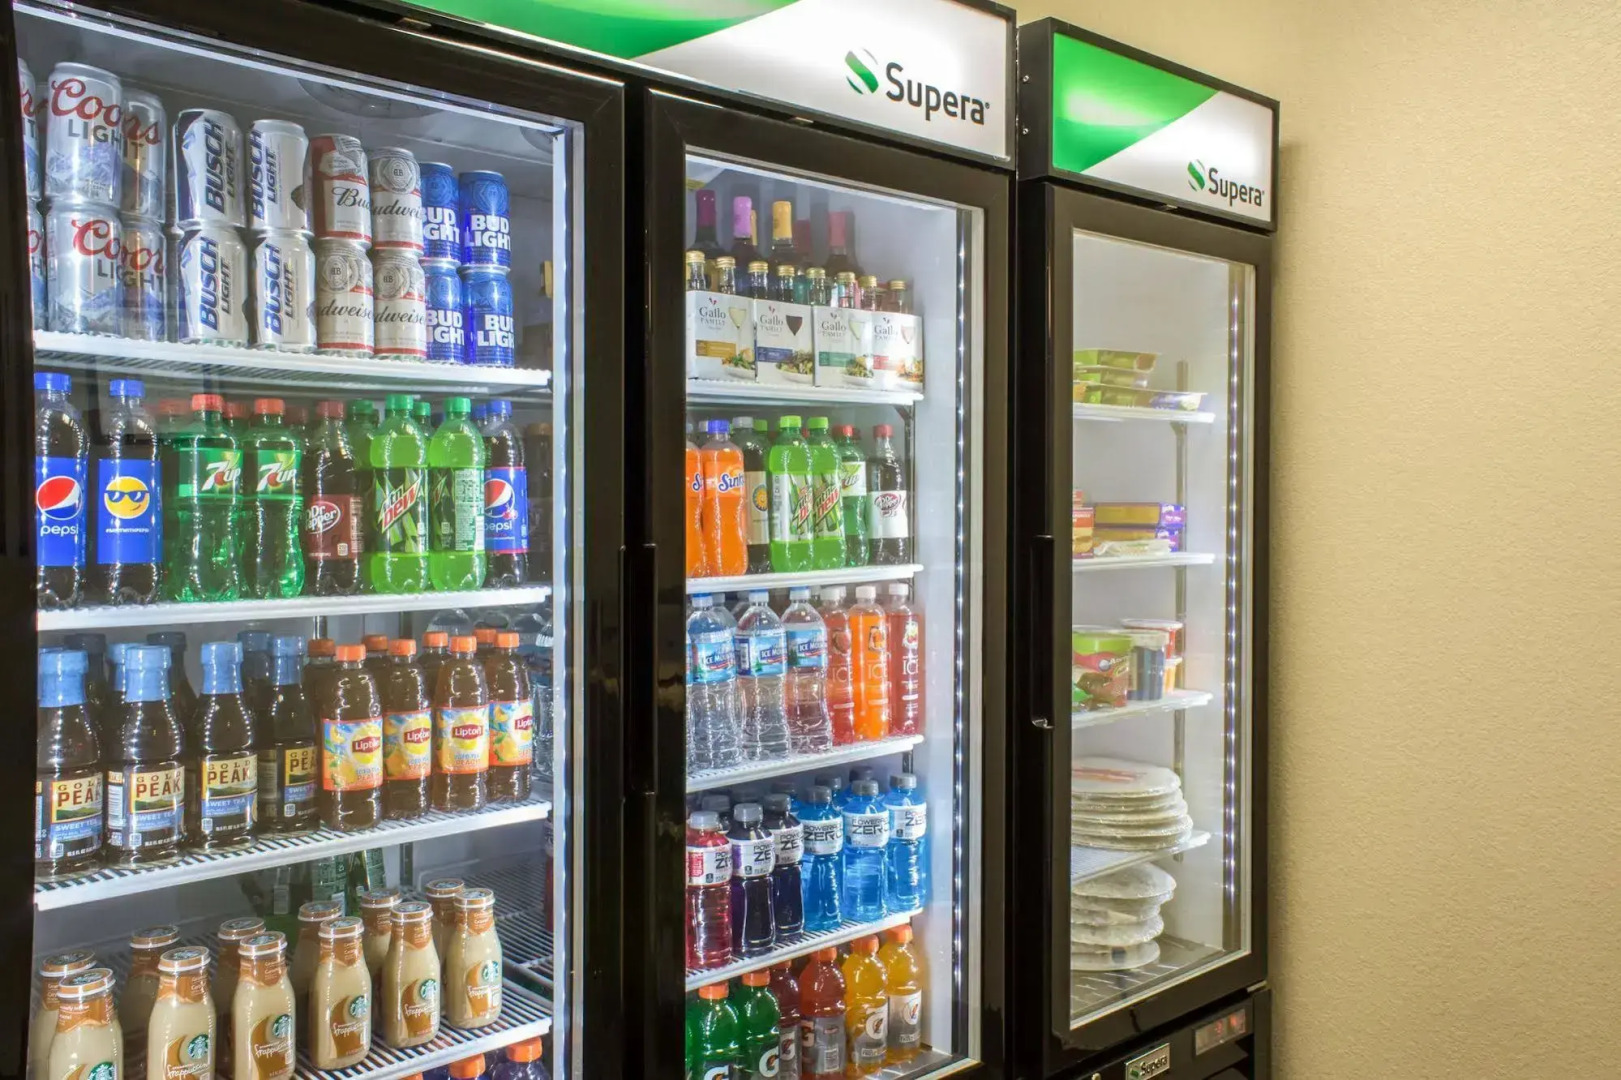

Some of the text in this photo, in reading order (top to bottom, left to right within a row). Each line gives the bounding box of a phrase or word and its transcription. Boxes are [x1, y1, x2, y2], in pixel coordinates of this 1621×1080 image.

[886, 62, 985, 126] Supera
[204, 117, 225, 215] BUSCH
[226, 145, 237, 199] LIGHT
[250, 128, 264, 221] BUSCH
[266, 146, 278, 204] LIGHT
[1208, 167, 1263, 207] Supera
[470, 214, 511, 232] BUD
[464, 232, 512, 252] LIGHT
[200, 235, 220, 332] BUSCH
[221, 257, 233, 316] LIGHT
[265, 242, 283, 336] BUSCH
[284, 262, 296, 320] LIGHT
[425, 310, 463, 328] BUD
[698, 306, 727, 320] Gallo
[760, 313, 784, 326] Gallo
[821, 319, 847, 332] Gallo
[40, 524, 79, 537] pepsi
[761, 650, 771, 660] ICE
[799, 642, 808, 652] ICE
[455, 726, 482, 737] Lipton
[208, 760, 251, 770] GOLD
[136, 770, 181, 783] GOLD
[207, 767, 250, 785] PEAK
[136, 778, 181, 798] PEAK
[55, 821, 83, 832] SWEET
[852, 825, 890, 835] ZERO
[804, 830, 843, 842] ZERO
[1138, 1054, 1169, 1078] Supera
